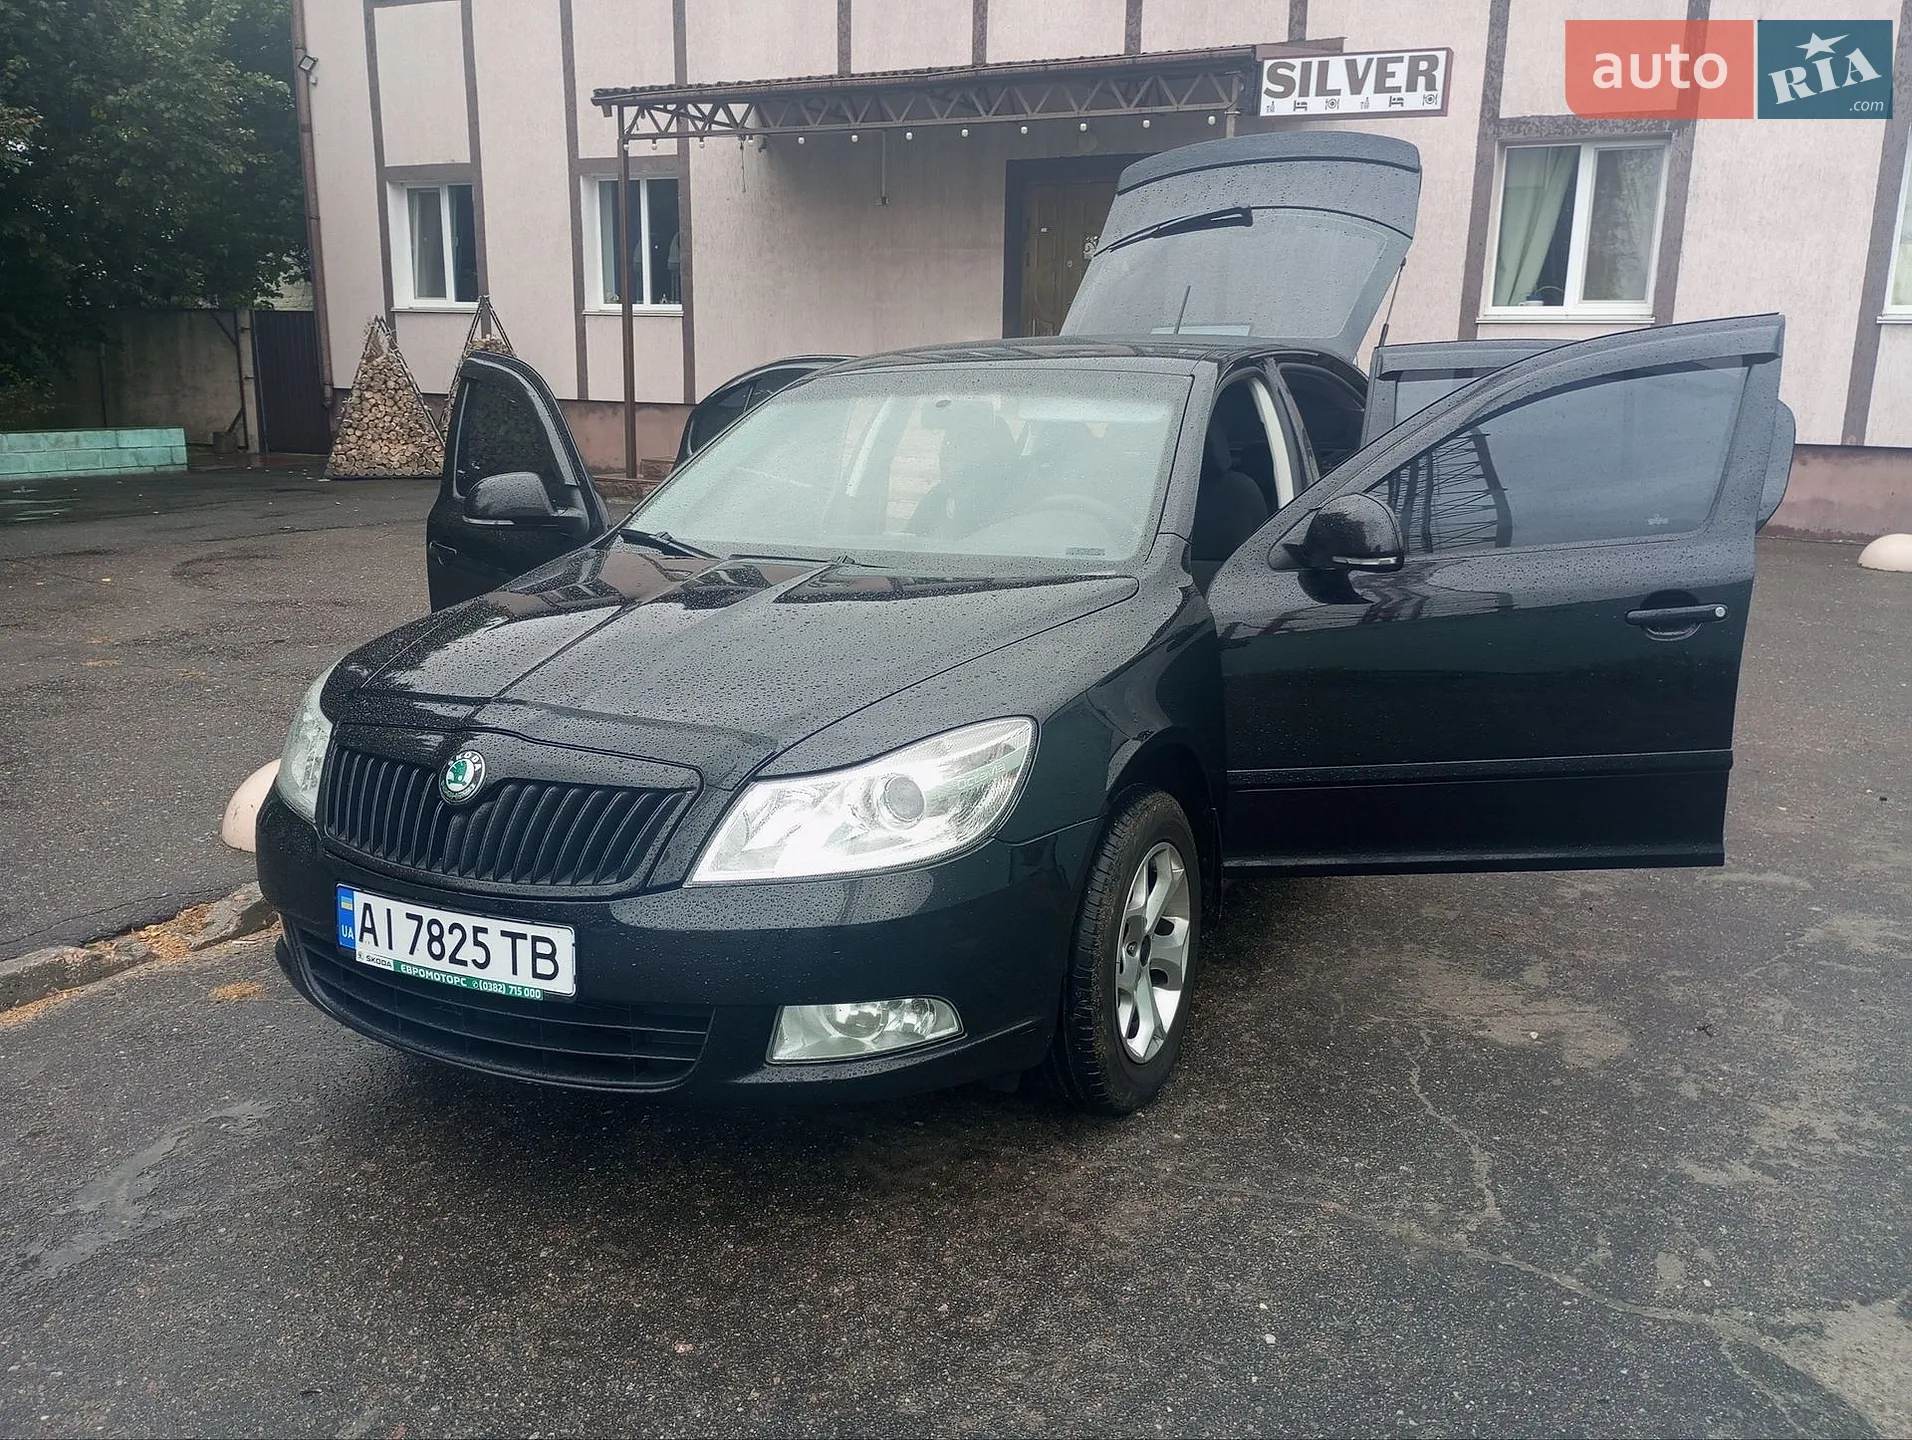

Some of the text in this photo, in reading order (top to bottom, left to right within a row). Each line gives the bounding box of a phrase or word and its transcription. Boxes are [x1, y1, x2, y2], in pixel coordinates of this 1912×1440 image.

[1263, 54, 1440, 99] SILVER
[341, 924, 355, 940] UA
[358, 902, 560, 981] AI 7825 TB
[366, 955, 393, 969] SKODA
[400, 964, 541, 999] ЄВРОМОТОРС (0382) 715 000
